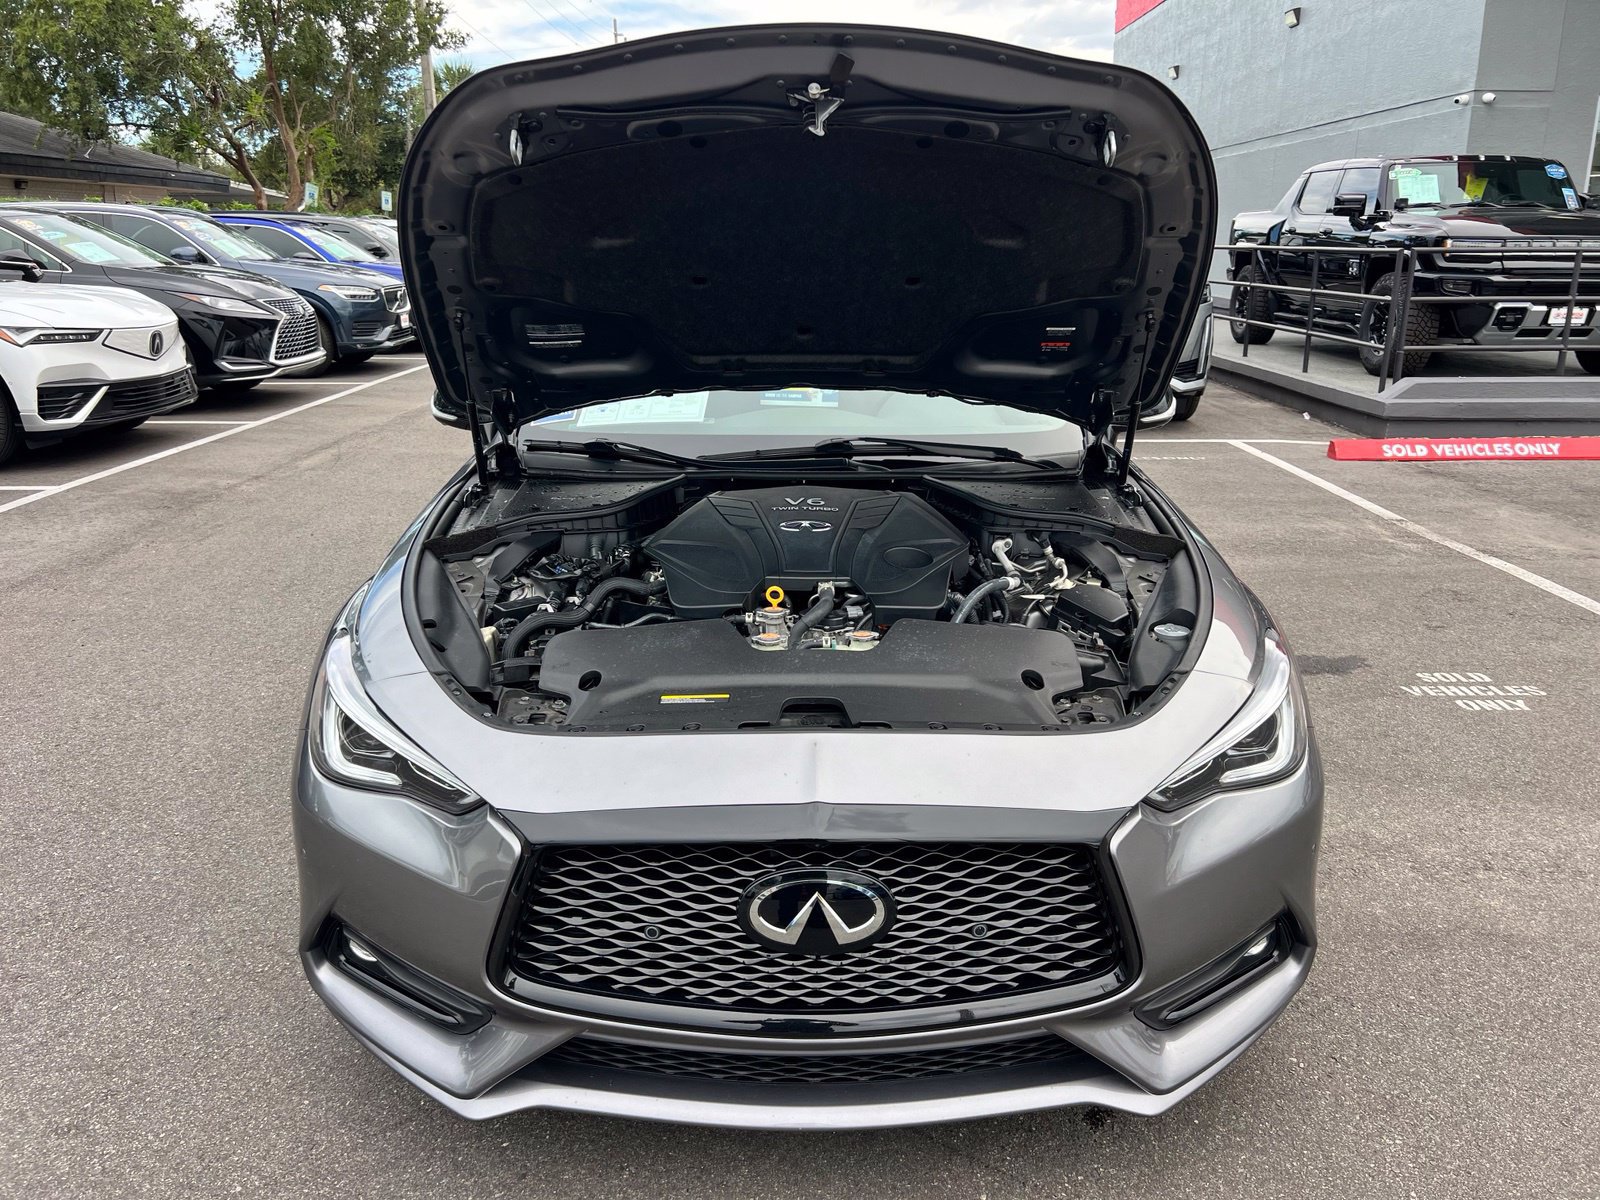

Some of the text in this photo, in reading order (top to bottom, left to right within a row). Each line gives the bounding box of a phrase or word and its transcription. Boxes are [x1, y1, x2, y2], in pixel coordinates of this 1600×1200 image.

[1381, 442, 1560, 457] SOLD VEHICLES ONLY
[784, 497, 825, 505] V6
[1415, 672, 1493, 683] SOLD
[1400, 685, 1547, 696] VEHICLES
[1454, 699, 1531, 711] ONLY
